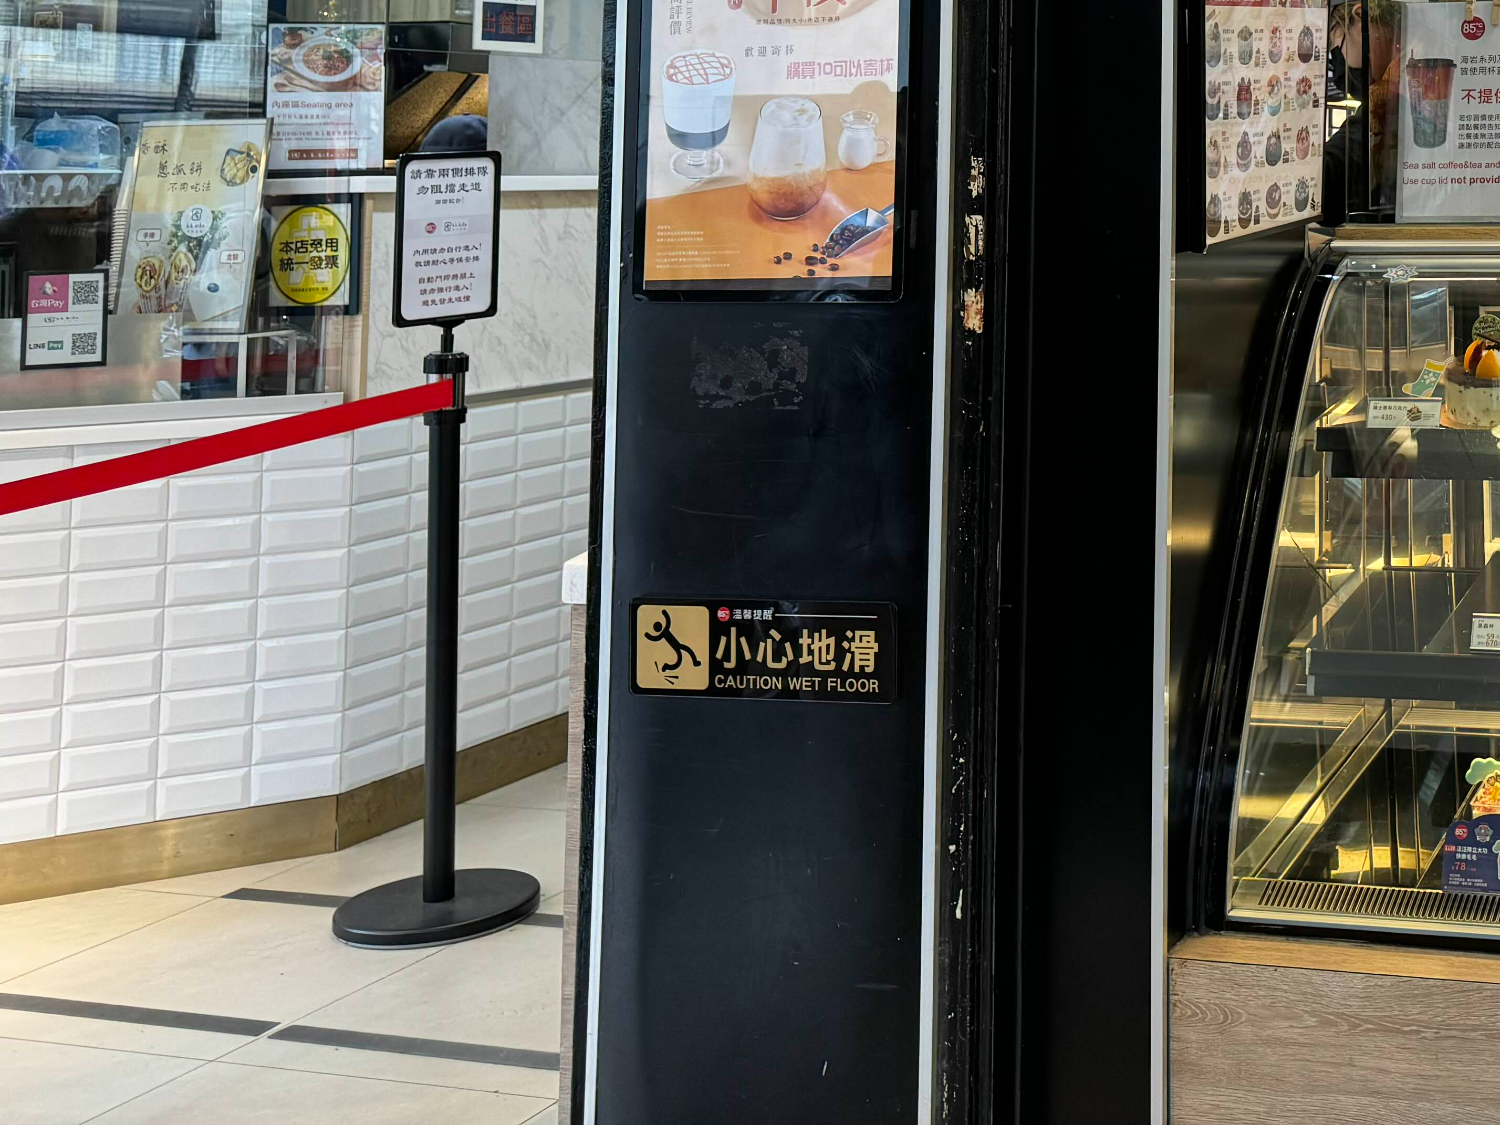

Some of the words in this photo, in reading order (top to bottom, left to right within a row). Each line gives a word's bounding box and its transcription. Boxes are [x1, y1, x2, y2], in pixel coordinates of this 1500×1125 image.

[482, 10, 533, 35] 出餐區
[744, 44, 795, 58] 歡迎寄杯
[786, 58, 894, 80] 購買10可以寄杯
[1403, 161, 1419, 170] Sea
[1422, 161, 1436, 169] salt
[1438, 161, 1482, 169] coffee&tea
[1485, 161, 1500, 169] and
[410, 166, 489, 180] 請靠兩側排隊
[1403, 177, 1419, 185] Use
[1421, 178, 1437, 186] cup
[1438, 176, 1448, 185] lid
[1450, 176, 1467, 185] not
[416, 182, 482, 195] 勿阻擋走道
[279, 238, 339, 255] 本店免用
[279, 255, 339, 272] 統一發票
[29, 342, 46, 350] LINE
[732, 607, 774, 621] 溫馨提醒
[716, 626, 879, 673] 小心地滑
[715, 674, 782, 690] CAUTION
[787, 676, 821, 691] WET
[827, 678, 879, 694] FLOOR
